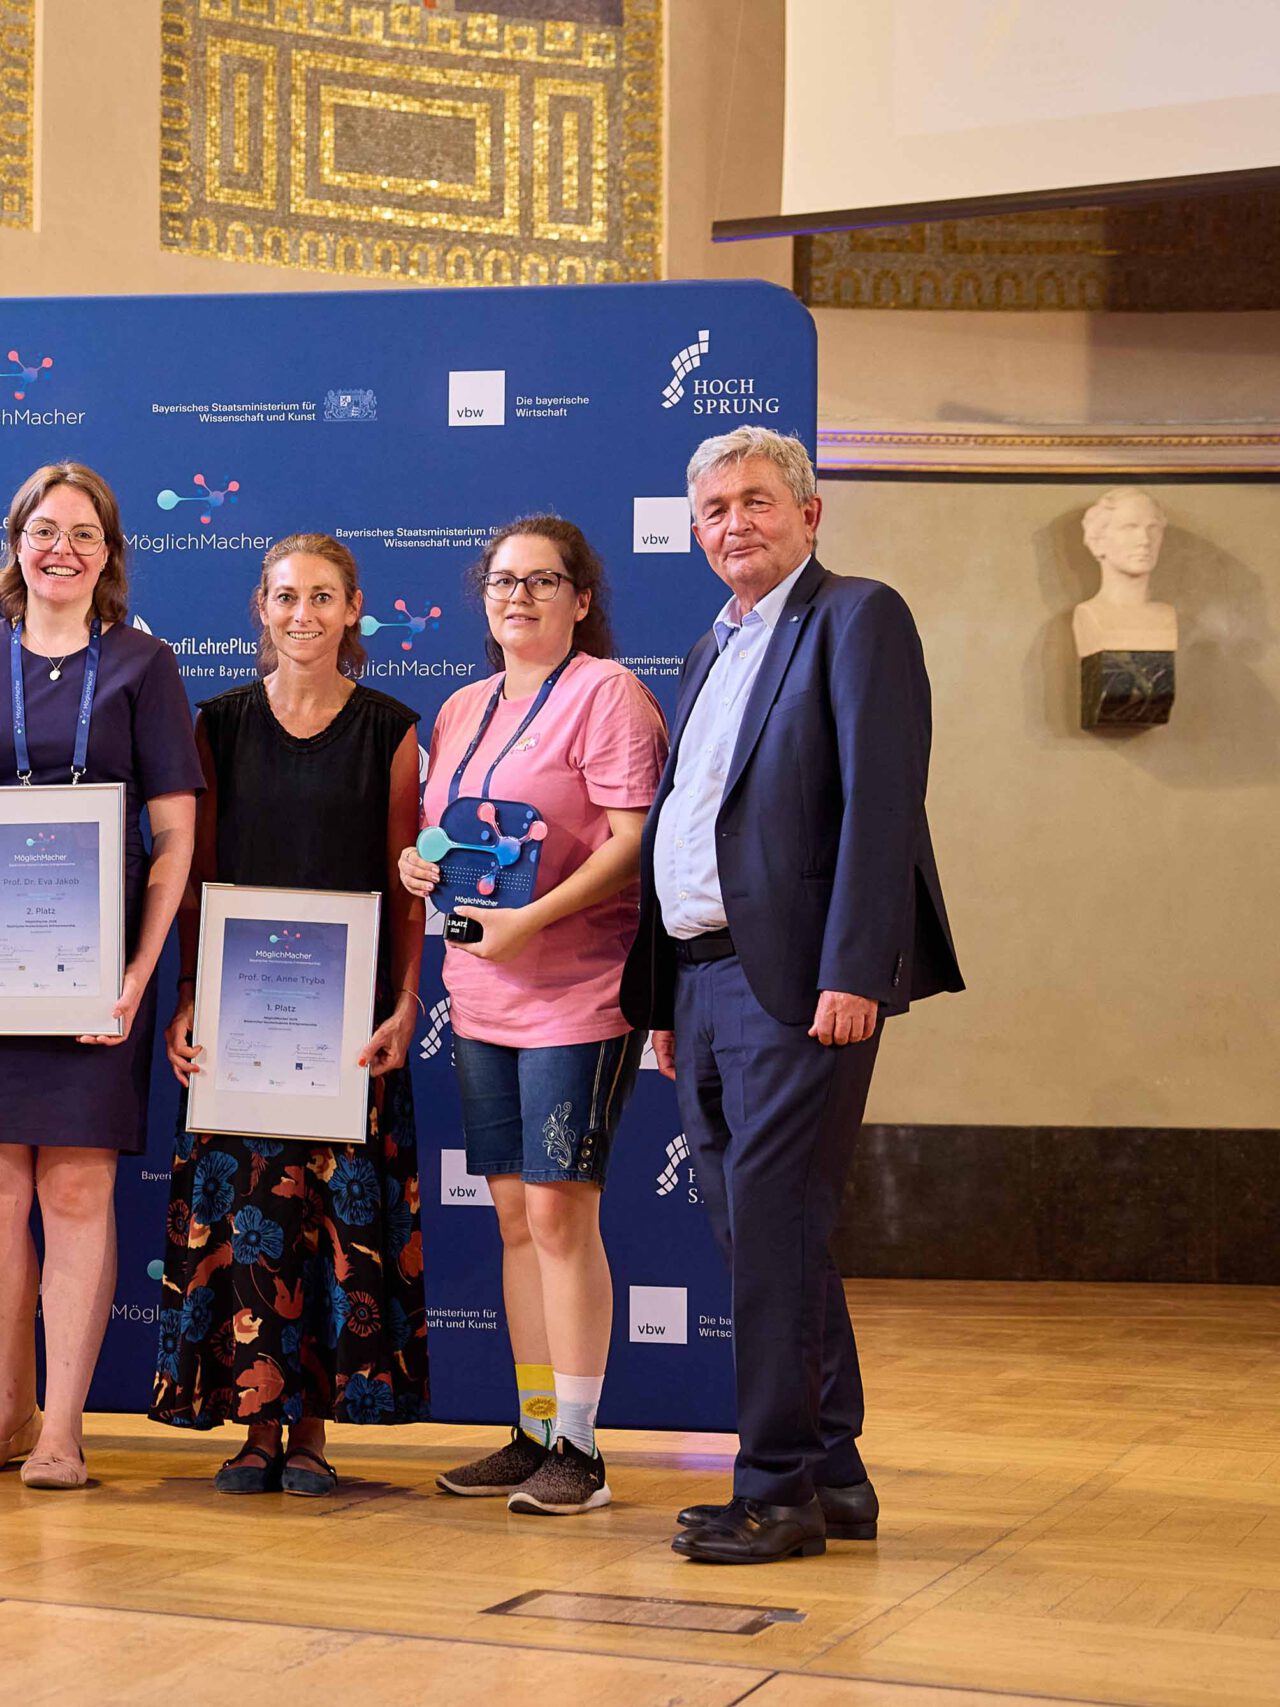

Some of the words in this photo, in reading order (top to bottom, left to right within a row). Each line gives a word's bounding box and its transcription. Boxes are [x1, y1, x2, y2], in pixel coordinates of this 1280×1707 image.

[694, 378, 754, 396] HOCH
[516, 396, 532, 406] Die
[535, 395, 590, 408] bayerische
[694, 398, 780, 415] SPRUNG
[152, 403, 210, 414] Bayerisches
[211, 402, 301, 412] Staatsministerium
[302, 401, 316, 412] für
[456, 406, 485, 419] vbw
[516, 407, 568, 418] Wirtschaft
[198, 414, 264, 423] Wissenschaft
[266, 413, 286, 422] und
[288, 412, 316, 422] Kunst
[336, 528, 394, 539] Bayerisches
[396, 526, 486, 537] Staatsministerium
[384, 538, 450, 548] Wissenschaft
[452, 538, 472, 547] und
[642, 534, 670, 545] vbw
[220, 666, 258, 680] Bayern
[660, 666, 680, 676] und
[14, 854, 68, 863] MöglichMacher
[38, 878, 53, 886] Eva
[54, 878, 80, 886] Jakob
[454, 896, 498, 907] MöglichMacher
[36, 907, 56, 915] Platz
[451, 920, 468, 928] PLATZ
[255, 950, 312, 960] MöglichMacher
[238, 973, 259, 982] Prof.
[261, 974, 274, 983] Dr.
[276, 975, 298, 984] Anne
[300, 976, 326, 986] Tryba
[274, 1004, 296, 1013] Platz
[141, 1171, 172, 1181] Bayeri
[448, 1182, 477, 1198] vbw
[483, 1309, 497, 1318] für
[446, 1320, 465, 1328] und
[468, 1320, 497, 1330] Kunst
[699, 1315, 716, 1326] Die
[638, 1322, 666, 1336] vbw
[698, 1328, 732, 1338] Wirtsc
